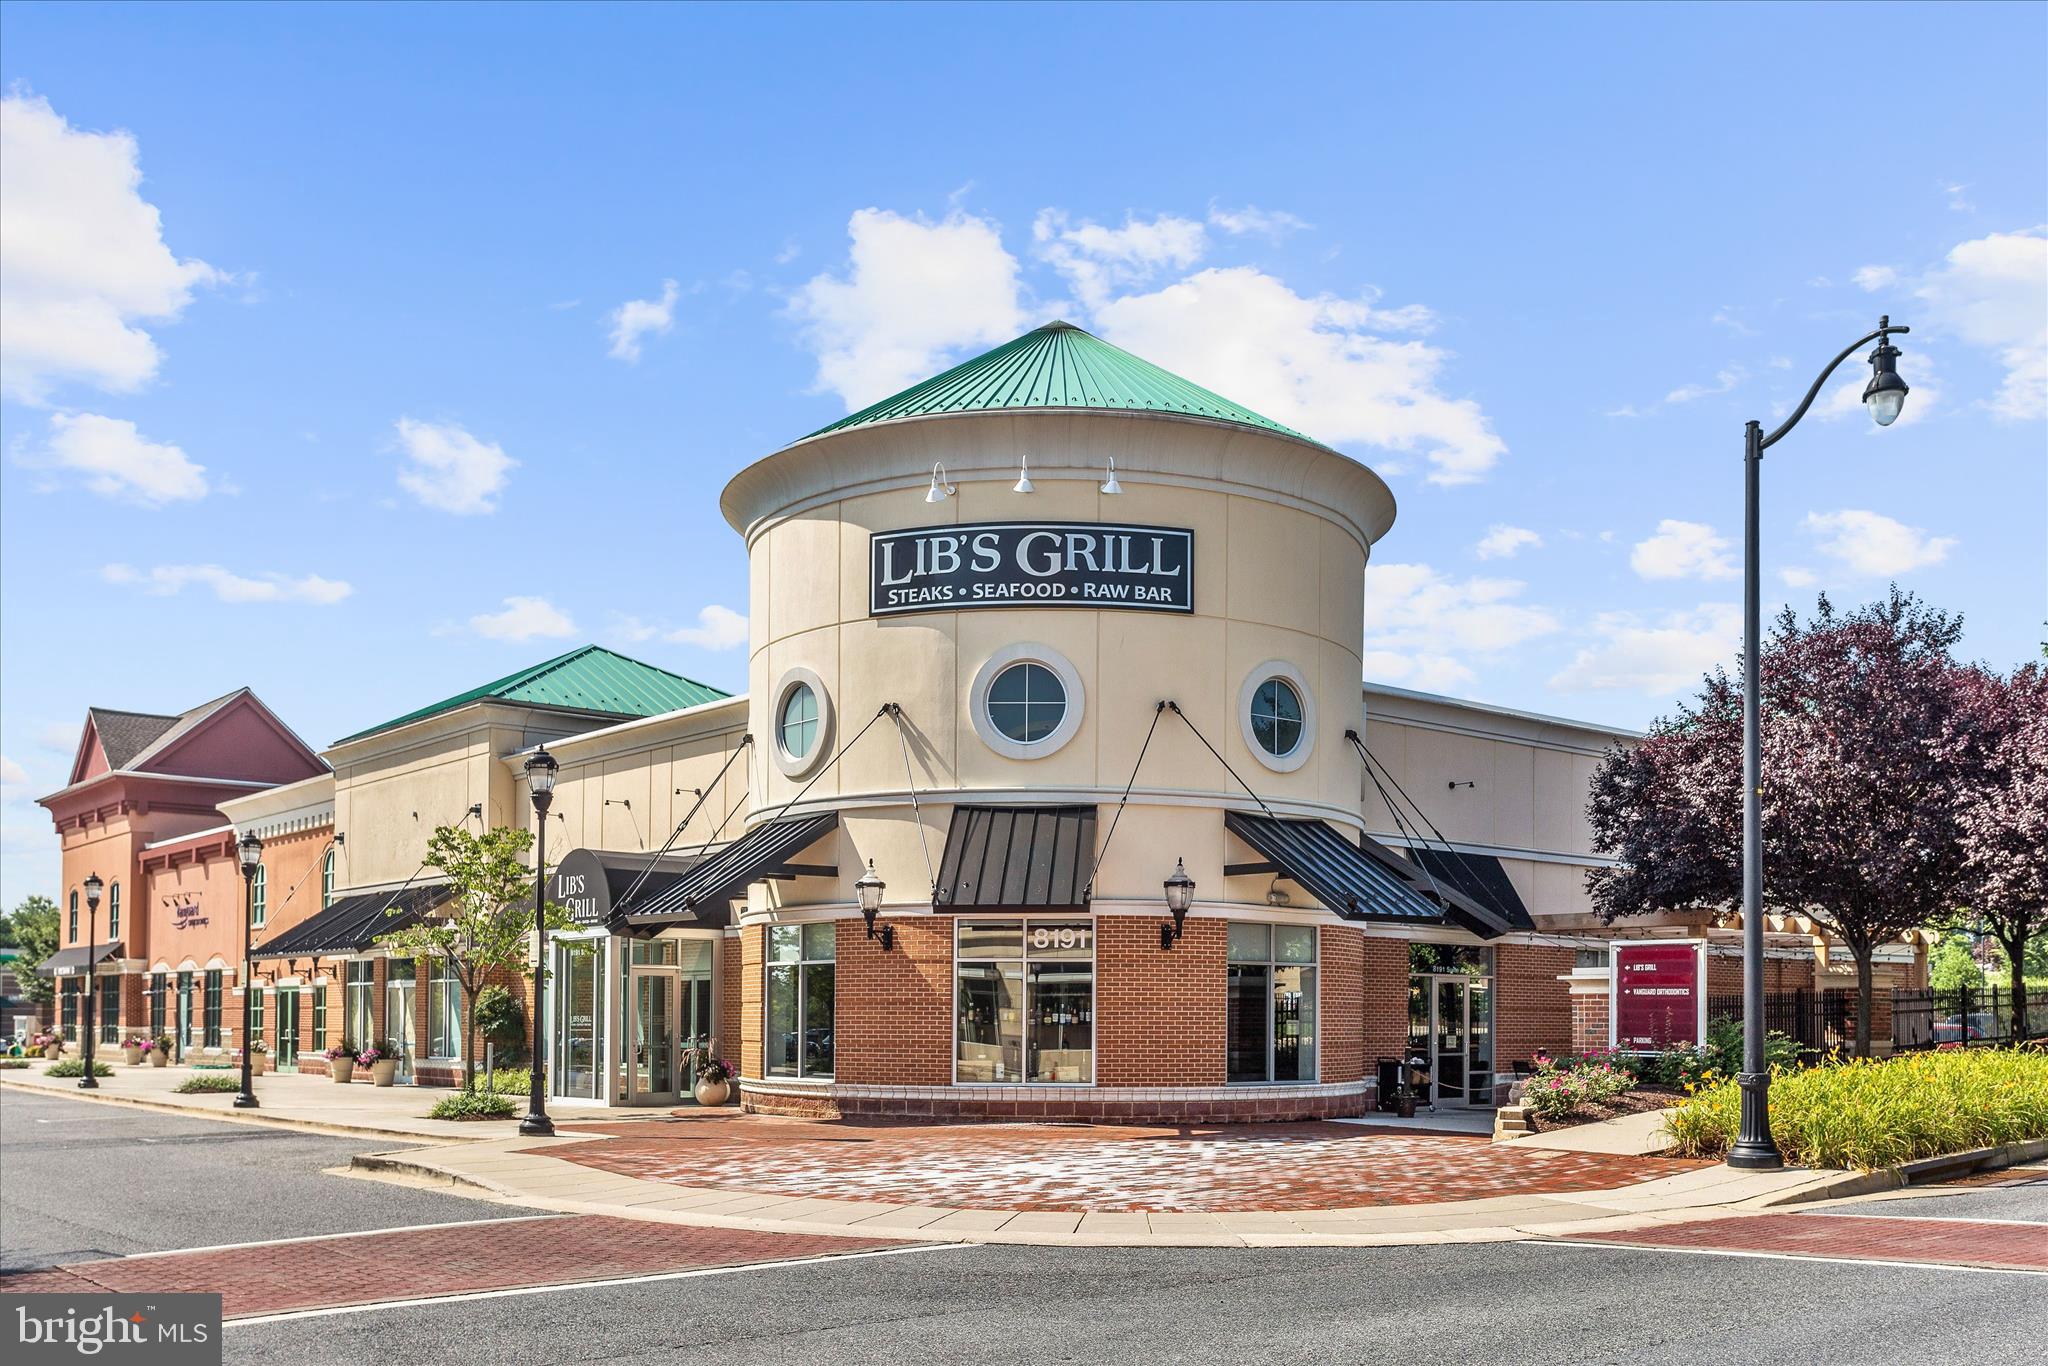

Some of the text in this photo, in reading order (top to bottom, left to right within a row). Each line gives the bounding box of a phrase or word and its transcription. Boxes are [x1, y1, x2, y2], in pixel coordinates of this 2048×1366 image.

[881, 531, 1181, 586] LIB'S GRILL
[888, 582, 1172, 605] STEAKS SEAFOOD RAW BAR
[558, 874, 585, 899] LIB'S
[565, 897, 599, 922] GRILL
[1033, 928, 1086, 949] 8191
